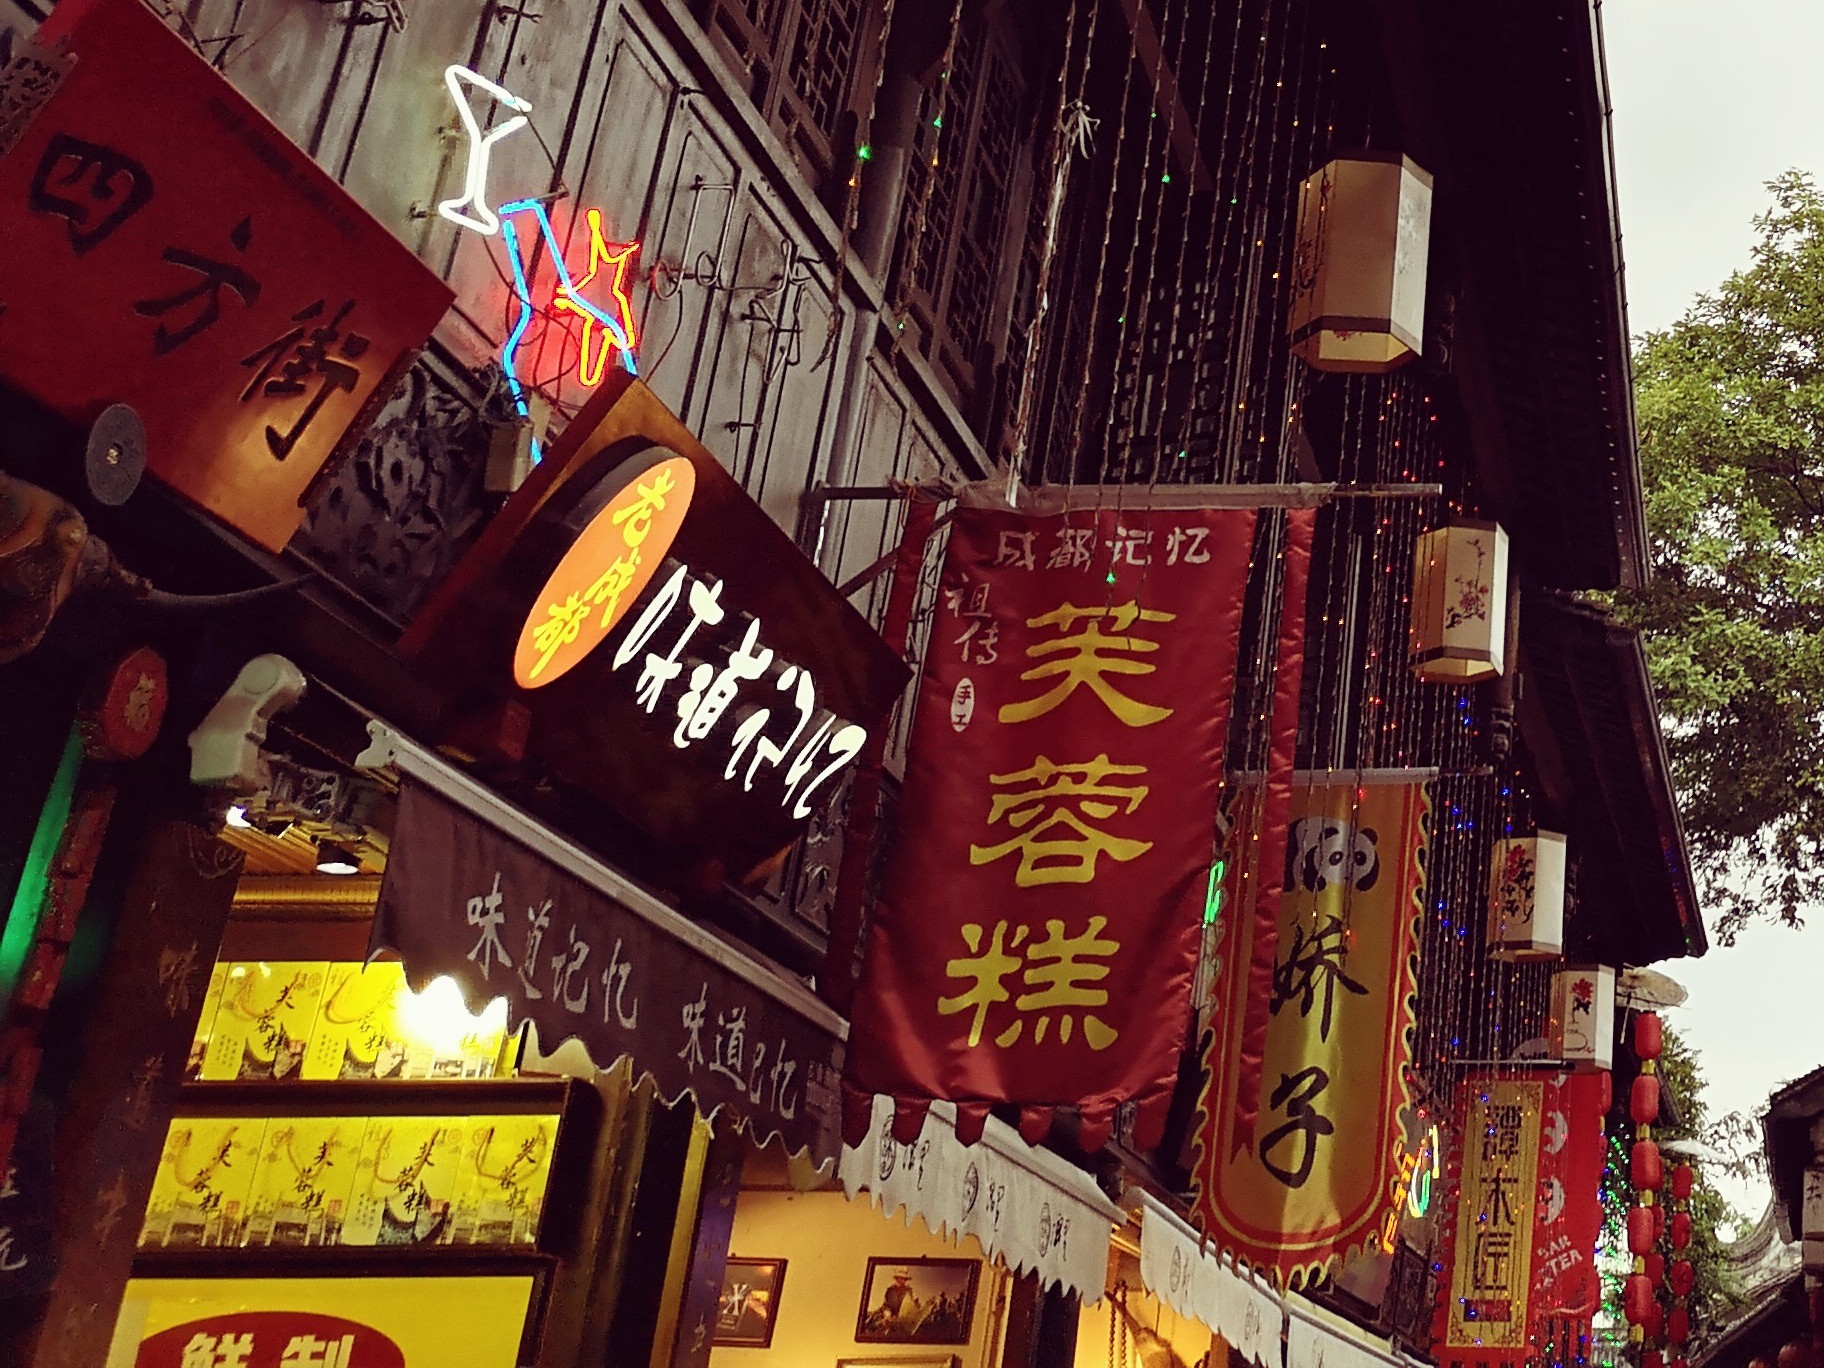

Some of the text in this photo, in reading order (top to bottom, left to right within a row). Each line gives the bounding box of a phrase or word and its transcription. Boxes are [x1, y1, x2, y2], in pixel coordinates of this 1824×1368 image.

[29, 134, 365, 461] 四方街
[943, 572, 1001, 665] 祖传
[993, 527, 1210, 572] 成都记忆
[612, 565, 867, 820] 味道记忆
[939, 600, 1174, 1050] 芙蓉糕
[467, 871, 638, 1030] 味道记忆
